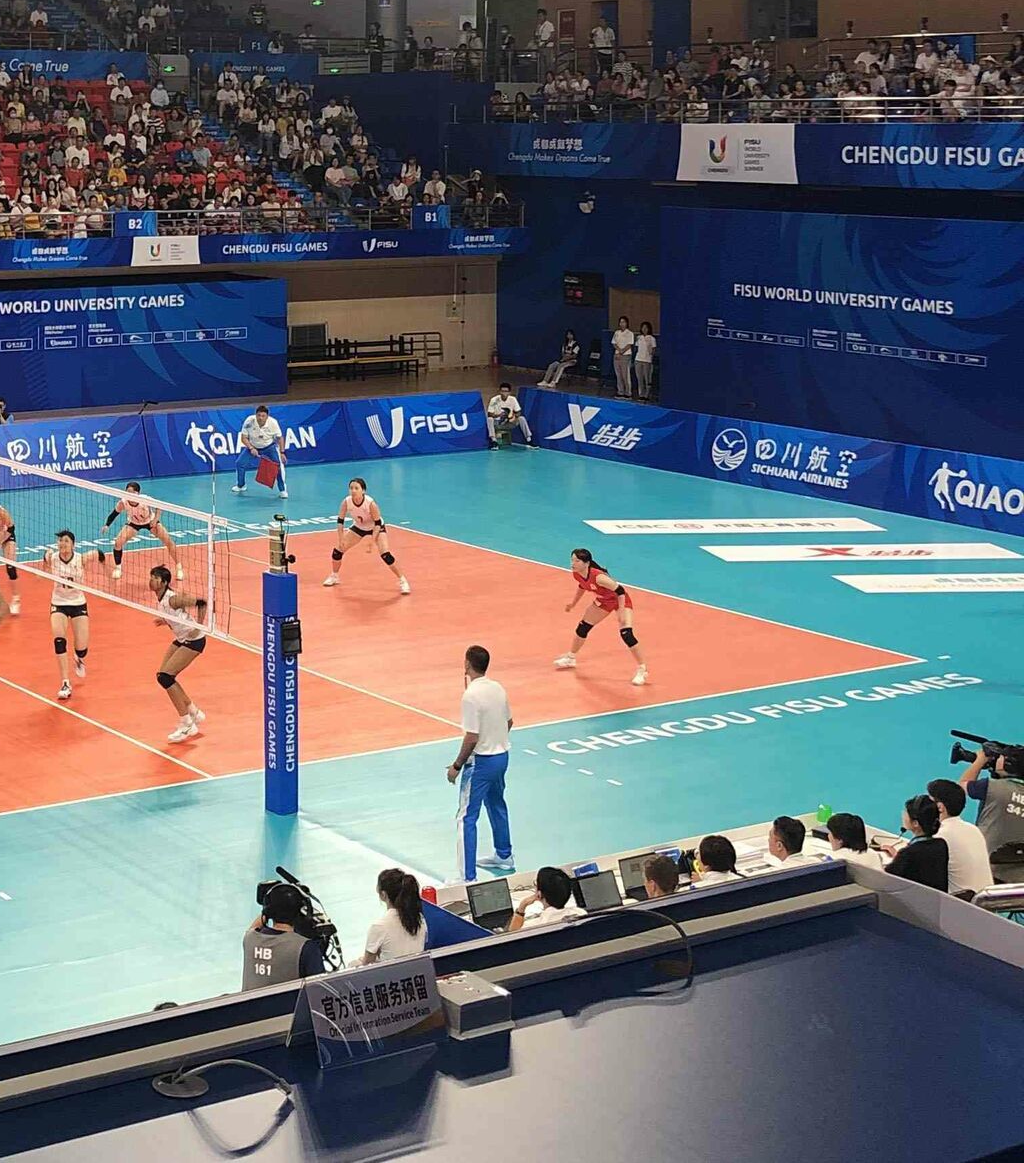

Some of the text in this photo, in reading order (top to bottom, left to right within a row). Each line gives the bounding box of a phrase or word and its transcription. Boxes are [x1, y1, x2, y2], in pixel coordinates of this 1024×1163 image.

[252, 42, 261, 50] F1
[45, 60, 69, 72] True
[842, 145, 938, 165] CHENGDU
[944, 147, 990, 166] FISU
[128, 219, 142, 229] B2
[425, 212, 437, 221] B1
[222, 242, 328, 255] CHENGDU FISU GAMES
[376, 241, 398, 249] FISU
[54, 297, 136, 313] UNIVERSITY
[138, 294, 185, 309] GAMES
[734, 283, 954, 315] FISU WORLD UNIVERSITY GAMES
[410, 413, 468, 434] FISU
[7, 431, 111, 461] 四川航空
[588, 423, 643, 451] 特步
[64, 458, 113, 471] AIRLINES
[754, 439, 857, 477] 四川航空
[751, 463, 849, 489] SICHUAN AIRLINES
[954, 479, 1024, 515] QIAO
[266, 615, 276, 769] CHENGDU FISU GAMES
[286, 670, 294, 700] FISU
[547, 673, 982, 755] CHENGDU FISU GAMES
[286, 704, 294, 772] CHENGDU
[254, 947, 272, 960] HB
[254, 963, 272, 976] 161
[321, 974, 428, 1022] 官方信息服务预留
[390, 1011, 414, 1022] Service
[414, 1007, 430, 1017] Team
